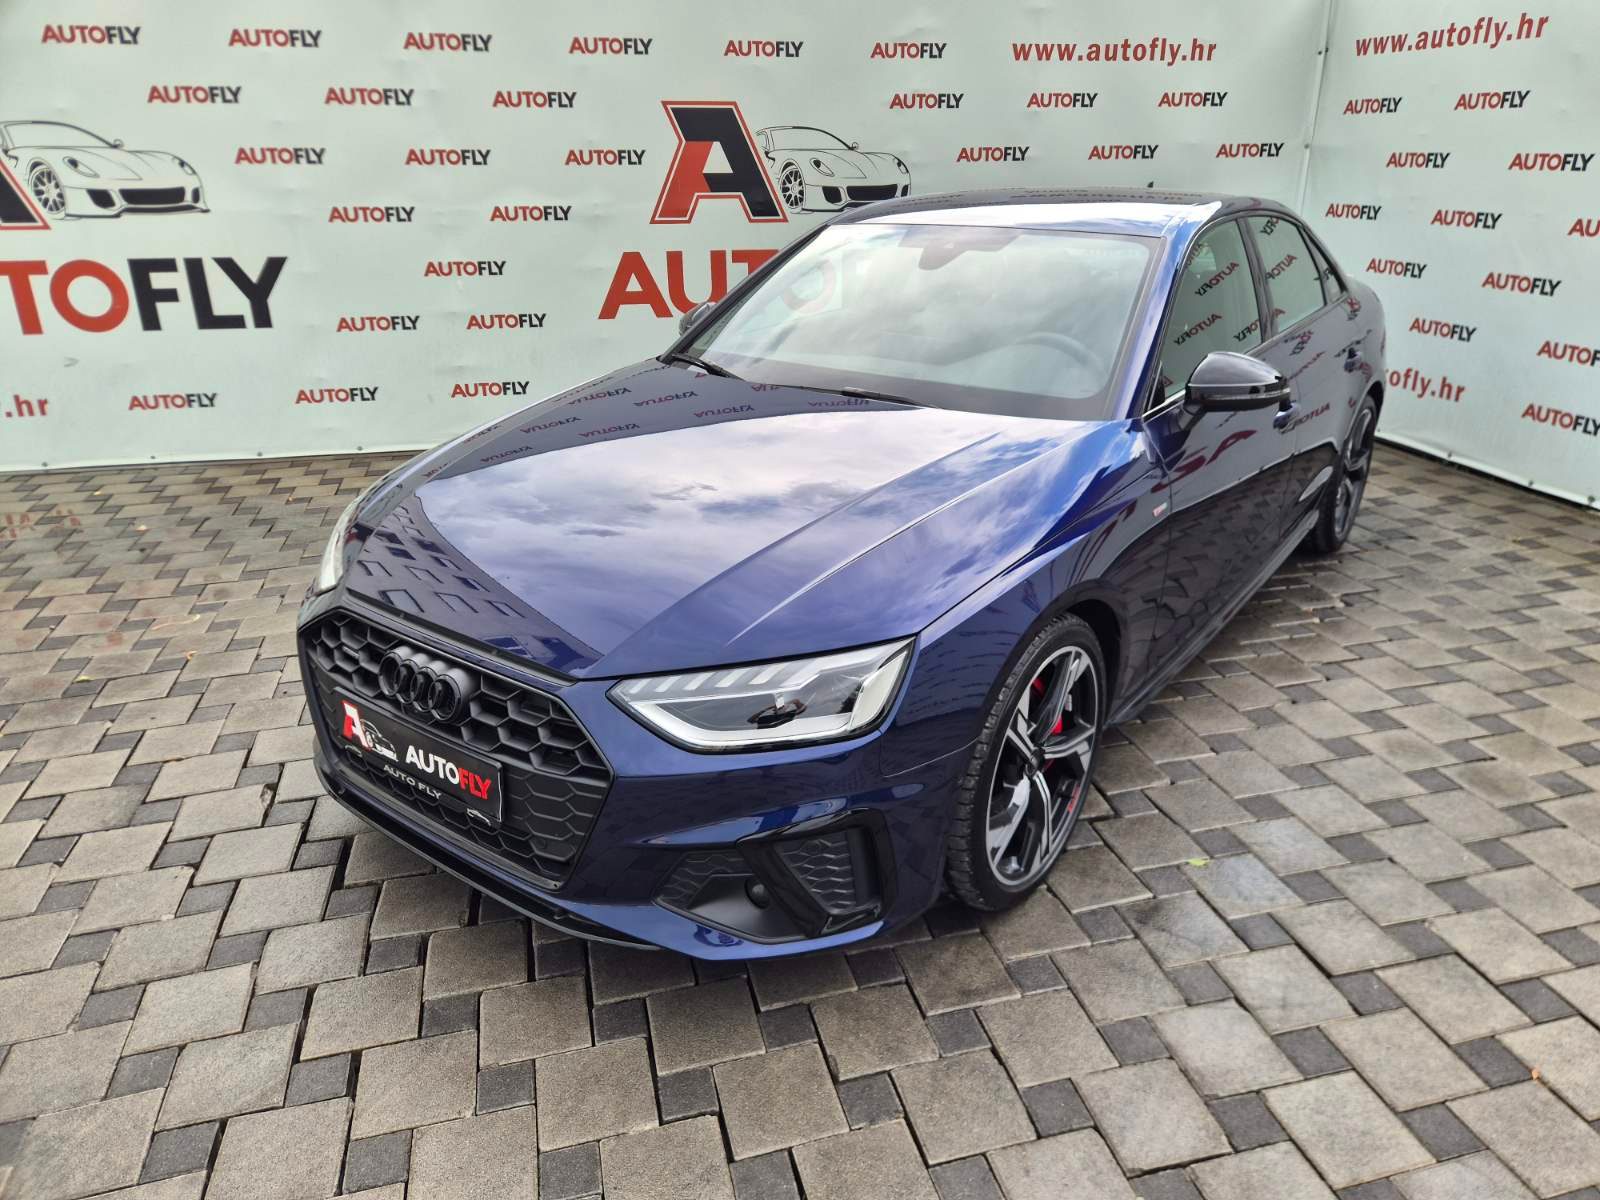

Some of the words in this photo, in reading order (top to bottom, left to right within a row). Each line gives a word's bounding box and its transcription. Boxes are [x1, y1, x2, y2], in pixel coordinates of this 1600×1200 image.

[42, 24, 140, 45] AUTOFLY
[229, 29, 322, 48] AUTOFLY
[404, 32, 492, 52] AUTOFLY
[1356, 13, 1549, 56] www.autofly.hr
[569, 37, 653, 55] AUTOFLY
[724, 40, 803, 57] AUTOFLY
[870, 43, 947, 59] AUTOFLY
[1012, 37, 1216, 66] www.autofly.hr
[148, 86, 241, 103] AUTOFLY
[325, 88, 414, 106] AUTOFLY
[493, 91, 577, 108] AUTOFLY
[890, 93, 964, 109] AUTOFLY
[1027, 93, 1098, 108] AUTOFLY
[1158, 92, 1228, 107] AUTOFLY
[1454, 90, 1531, 110] AUTOFLY
[1343, 97, 1402, 114] AUTOFLY
[235, 148, 325, 164] AUTOFLY
[405, 149, 491, 165] AUTOFLY
[565, 149, 646, 166] AUTOFLY
[957, 147, 1029, 162] AUTOFLY
[1088, 145, 1159, 160] AUTOFLY
[1216, 143, 1285, 158] AUTOFLY
[1386, 152, 1450, 168] AUTOFLY
[1508, 153, 1595, 171] AUTOFLY
[328, 207, 415, 223] AUTOFLY
[490, 206, 572, 222] AUTOFLY
[1325, 203, 1382, 220] AUTOFLY
[1431, 209, 1502, 229] AUTOFLY
[424, 261, 506, 277] AUTOFLY
[1366, 258, 1427, 279] AUTOFLY
[1482, 272, 1561, 296] AUTOFLY
[337, 315, 420, 332] AUTOFLY
[467, 313, 546, 330] AUTOFLY
[1409, 318, 1477, 342] AUTOFLY
[451, 381, 529, 398] AUTOFLY
[1386, 367, 1466, 402] ofly.hr
[129, 393, 217, 410] AUTOFLY
[296, 387, 378, 404] AUTOFLY
[1521, 403, 1600, 436] AUTOFLY
[405, 745, 492, 800] AUTOFLY
[383, 764, 416, 786] AUTO
[418, 782, 442, 800] FLY
